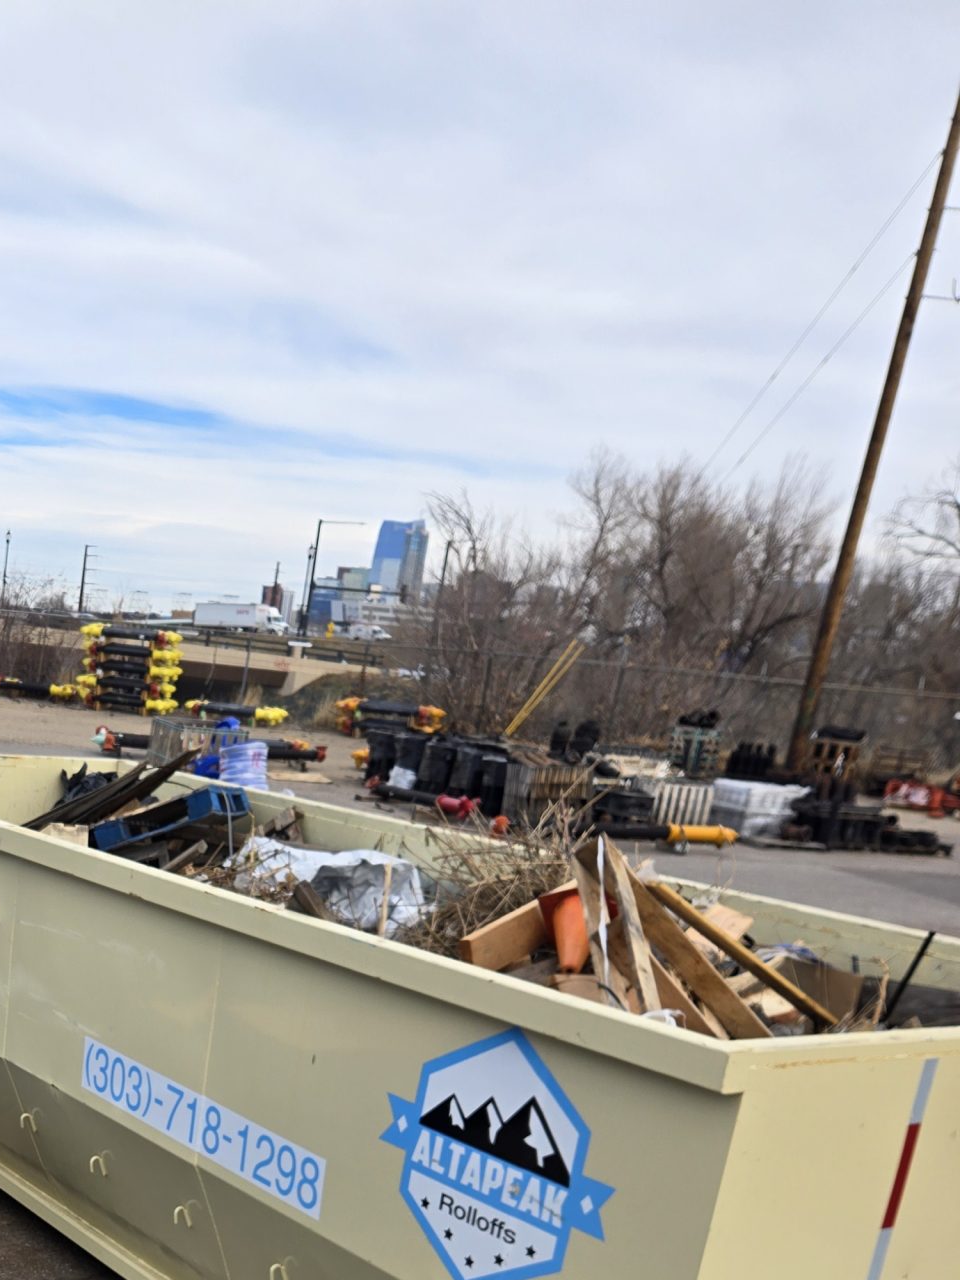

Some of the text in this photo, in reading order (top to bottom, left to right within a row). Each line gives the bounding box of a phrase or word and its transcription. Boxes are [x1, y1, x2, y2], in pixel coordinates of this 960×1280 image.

[85, 1043, 320, 1210] (303)-718-1298
[411, 1129, 569, 1229] ALTAPEAK
[438, 1193, 517, 1245] Rolloffs
